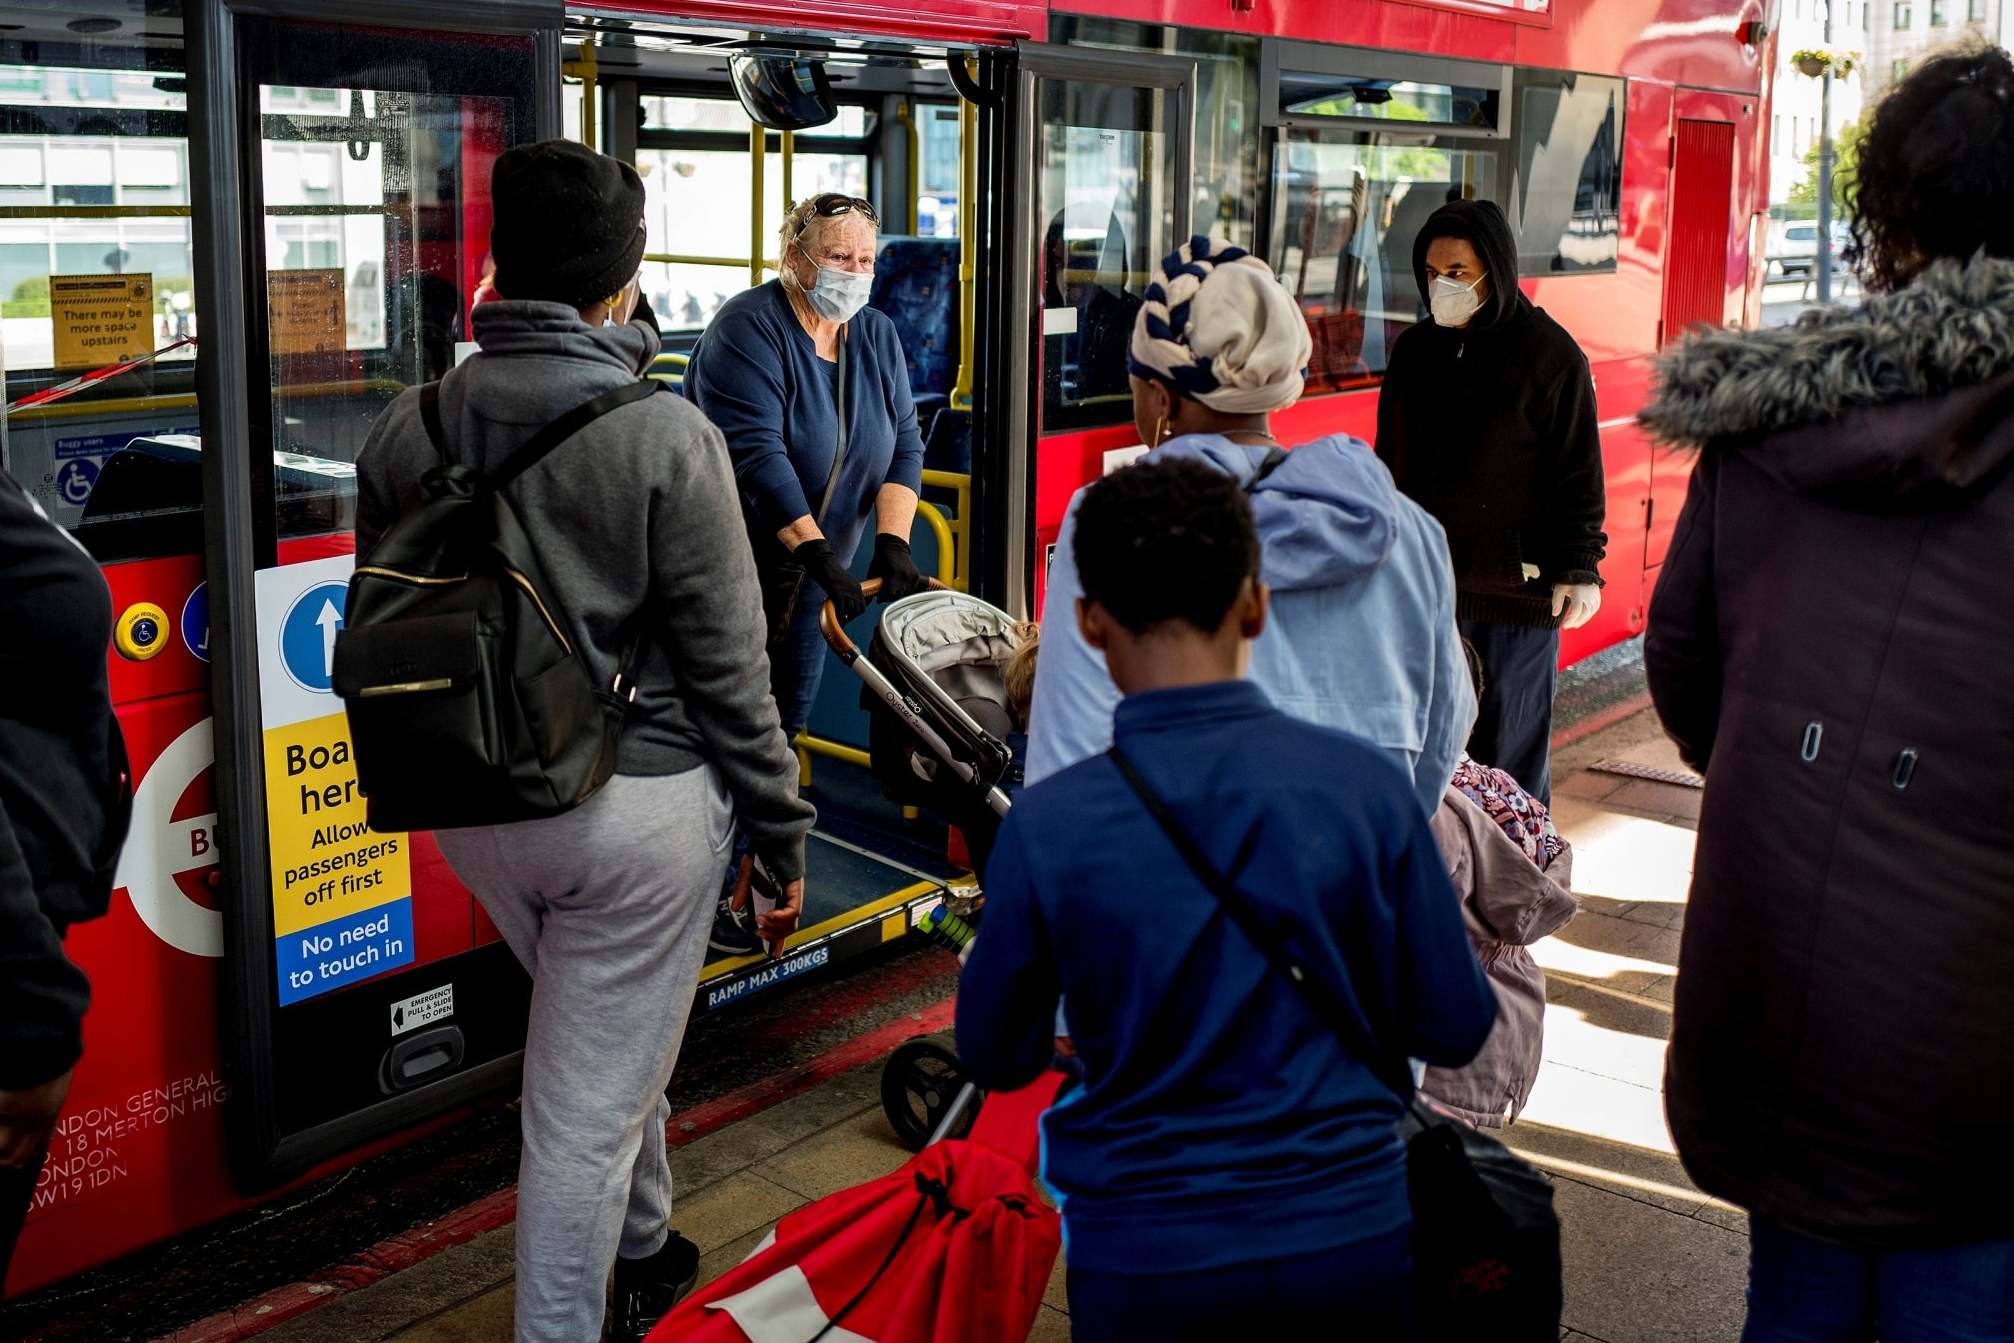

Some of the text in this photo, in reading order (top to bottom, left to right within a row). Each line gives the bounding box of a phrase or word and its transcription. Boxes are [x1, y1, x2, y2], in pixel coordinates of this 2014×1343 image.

[64, 308, 143, 320] There may be
[70, 323, 136, 333] more space
[81, 336, 128, 348] upstairs
[287, 740, 350, 776] Boa
[300, 778, 357, 815] her
[311, 821, 369, 849] Allow
[284, 839, 398, 889] passengers
[304, 869, 382, 906] off first
[302, 914, 389, 959] No need
[290, 939, 403, 988] to touch in
[708, 946, 829, 1006] RAMP MAX 300KGS
[408, 1006, 424, 1017] PULL
[433, 996, 452, 1008] SLIDE
[411, 988, 451, 1007] EMERGENCY
[422, 1012, 431, 1020] TO
[433, 1004, 452, 1016] OPEN
[55, 1071, 221, 1136] NDON GENERAL
[66, 1134, 88, 1155] 18
[96, 1100, 185, 1145] MERTON
[36, 1147, 118, 1187] ONDON
[89, 1165, 128, 1189] 1DN
